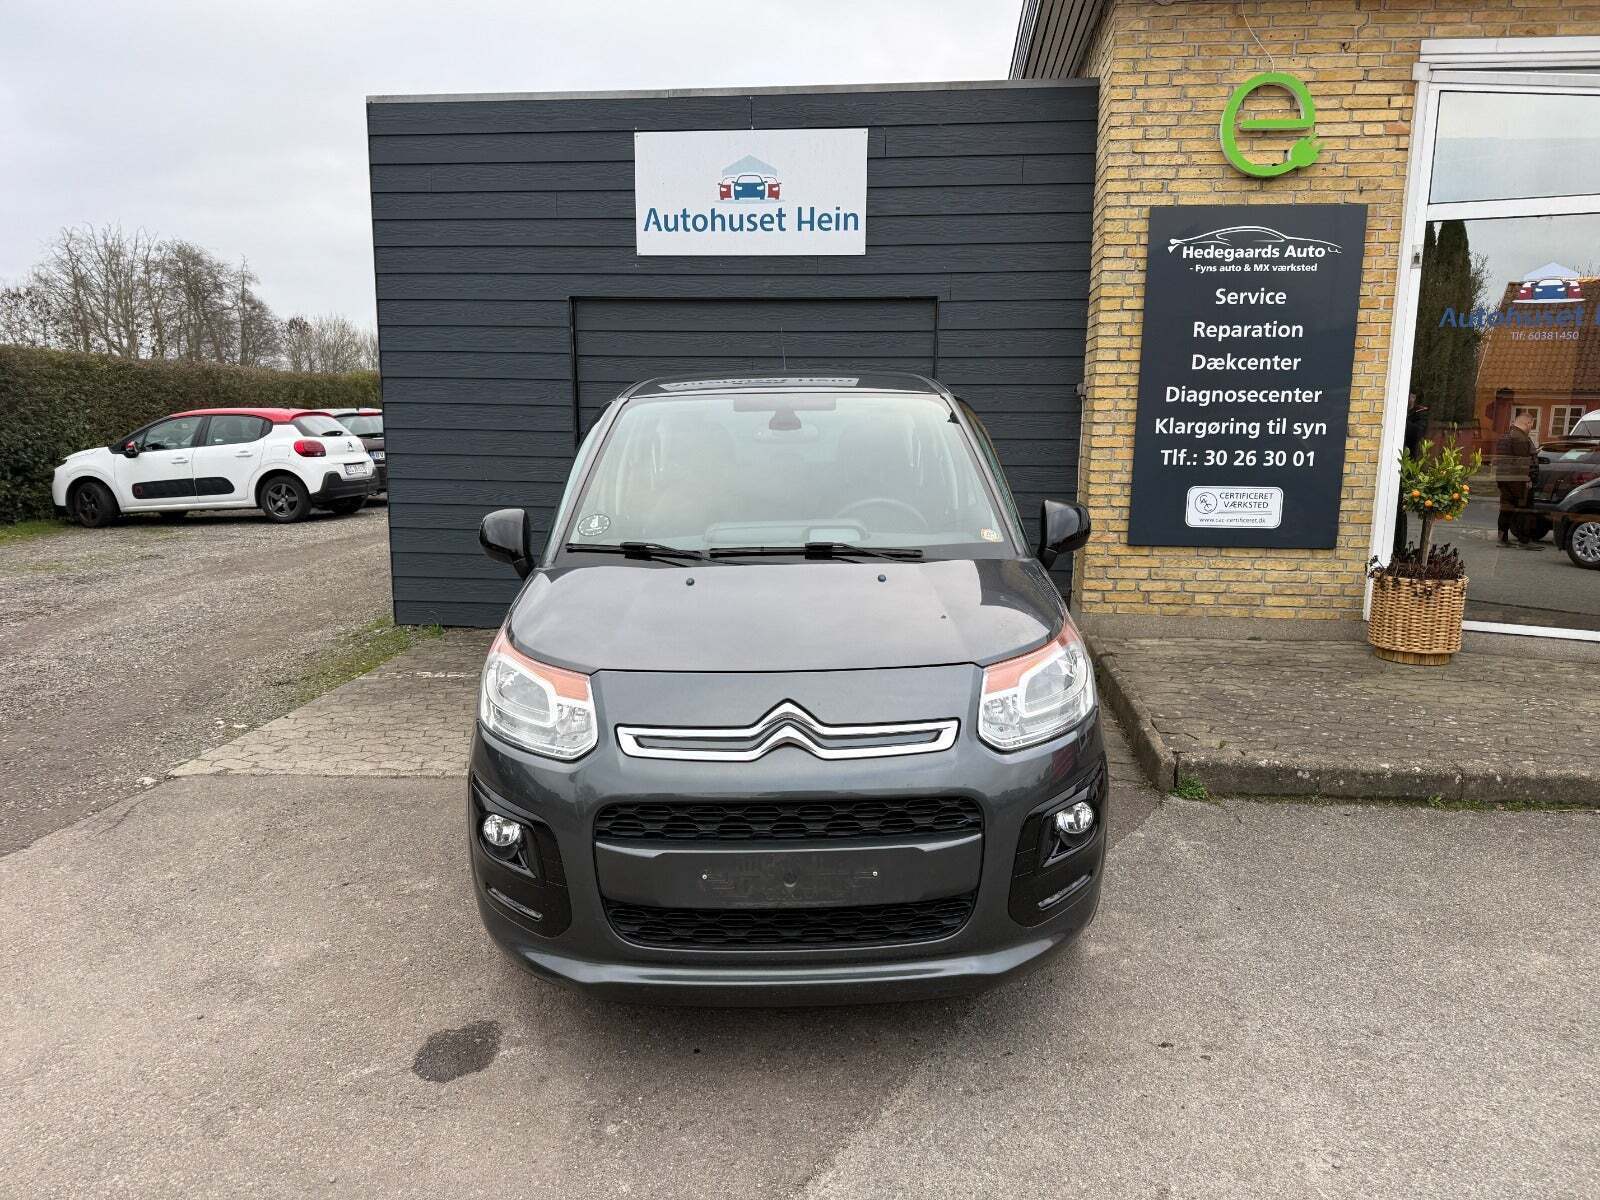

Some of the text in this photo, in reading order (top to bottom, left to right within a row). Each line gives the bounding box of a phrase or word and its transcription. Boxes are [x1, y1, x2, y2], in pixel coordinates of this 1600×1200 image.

[643, 206, 859, 233] Autohuset Hein
[1182, 244, 1326, 262] Hedegaards Auto
[1195, 264, 1218, 274] Fyns
[1219, 264, 1242, 272] auto
[1243, 264, 1252, 272] &
[1253, 264, 1270, 272] MX
[1272, 263, 1318, 272] værksted
[1215, 287, 1287, 305] Service
[1438, 305, 1585, 328] Autohuset
[1193, 320, 1304, 342] Reparation
[1527, 331, 1579, 341] 60381450
[1191, 352, 1302, 371] Dækcenter
[1165, 385, 1323, 407] Diagnosecenter
[1155, 416, 1327, 440] Klargøring til syn
[1160, 448, 1315, 467] Tlf.: 30 26 30 01
[1219, 492, 1273, 500] CERTIFICERET
[1223, 501, 1269, 509] VÆRKSTED
